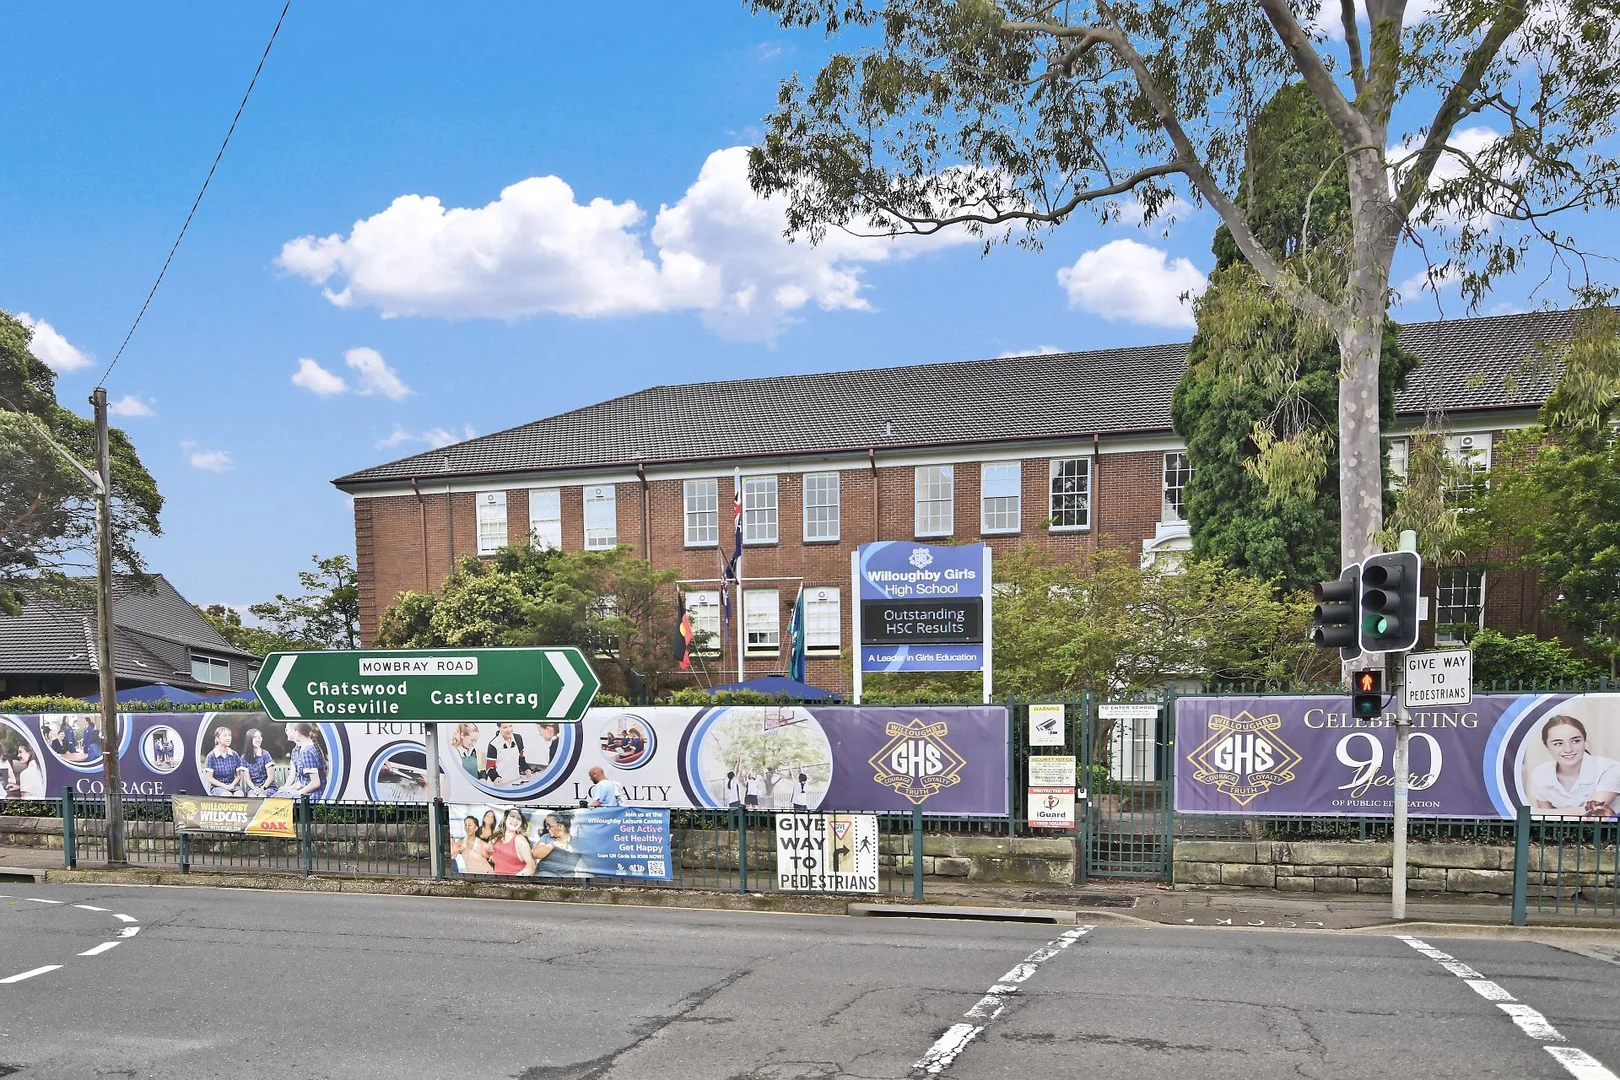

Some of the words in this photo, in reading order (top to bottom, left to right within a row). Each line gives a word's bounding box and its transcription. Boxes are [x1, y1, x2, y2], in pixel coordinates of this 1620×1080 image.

[868, 571, 941, 583] Willoughby
[944, 569, 976, 580] Girls
[885, 584, 913, 597] High
[916, 583, 958, 595] School
[884, 608, 965, 622] Outstanding
[886, 623, 913, 634] HSC
[916, 622, 964, 634] Results
[877, 654, 905, 662] Leader
[916, 653, 934, 661] Girls
[936, 652, 977, 661] Education
[1409, 658, 1436, 670] GIVE
[1443, 656, 1467, 668] WAY
[363, 660, 429, 672] MOWBRAY
[437, 659, 474, 671] ROAD
[1431, 673, 1445, 684] TO
[307, 681, 407, 696] Chatswood
[1410, 688, 1466, 701] PEDESTRIANS
[430, 690, 539, 709] Castlecrag
[313, 699, 399, 714] Roseville
[1214, 717, 1273, 730] WILLOUGHBY
[891, 725, 941, 736] WILLOUGHBY
[891, 740, 943, 777] GHS
[1215, 734, 1274, 775] GHS
[884, 776, 910, 784] COURAGE
[924, 777, 950, 785] LOYALTY
[1205, 773, 1236, 783] COURAGE
[1251, 774, 1282, 783] LOYALTY
[76, 778, 165, 795] CORAGE
[573, 782, 672, 802] LALTY
[201, 802, 248, 812] WILLOUGHBY
[201, 811, 248, 823] WILDCATS
[588, 817, 621, 825] Willoughby
[261, 822, 287, 830] OAK
[637, 825, 663, 833] Active
[779, 818, 826, 831] GIVE
[613, 834, 628, 842] Get
[630, 834, 663, 843] Healthy
[780, 837, 826, 850] WAY
[619, 843, 634, 851] Get
[636, 844, 663, 853] Happy
[790, 856, 817, 870] TO
[780, 874, 876, 890] PEDESTRIANS
